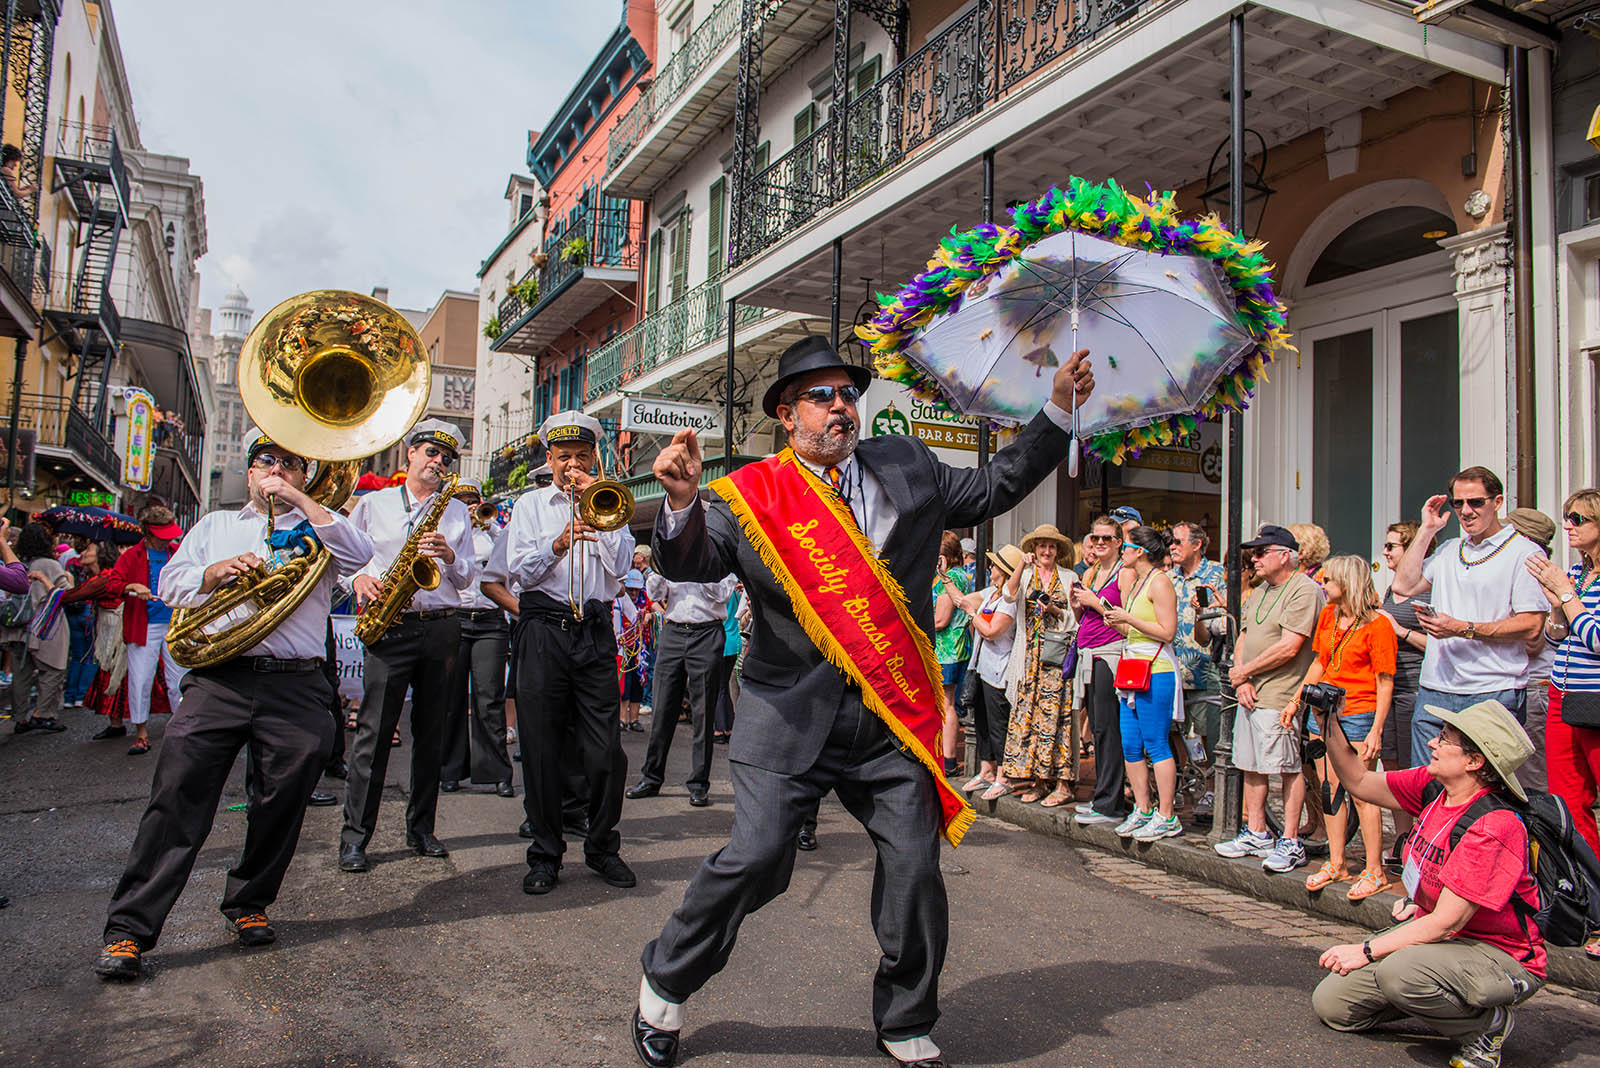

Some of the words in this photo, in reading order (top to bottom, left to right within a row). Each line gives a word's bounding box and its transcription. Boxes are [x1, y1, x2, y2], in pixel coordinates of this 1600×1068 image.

[633, 403, 718, 430] Galatoire's
[876, 417, 906, 437] 33
[131, 403, 146, 478] GATEWAY
[918, 428, 942, 442] BAR
[945, 431, 954, 443] &
[787, 519, 849, 594] Society
[842, 594, 892, 655] Brass
[886, 652, 920, 703] Band
